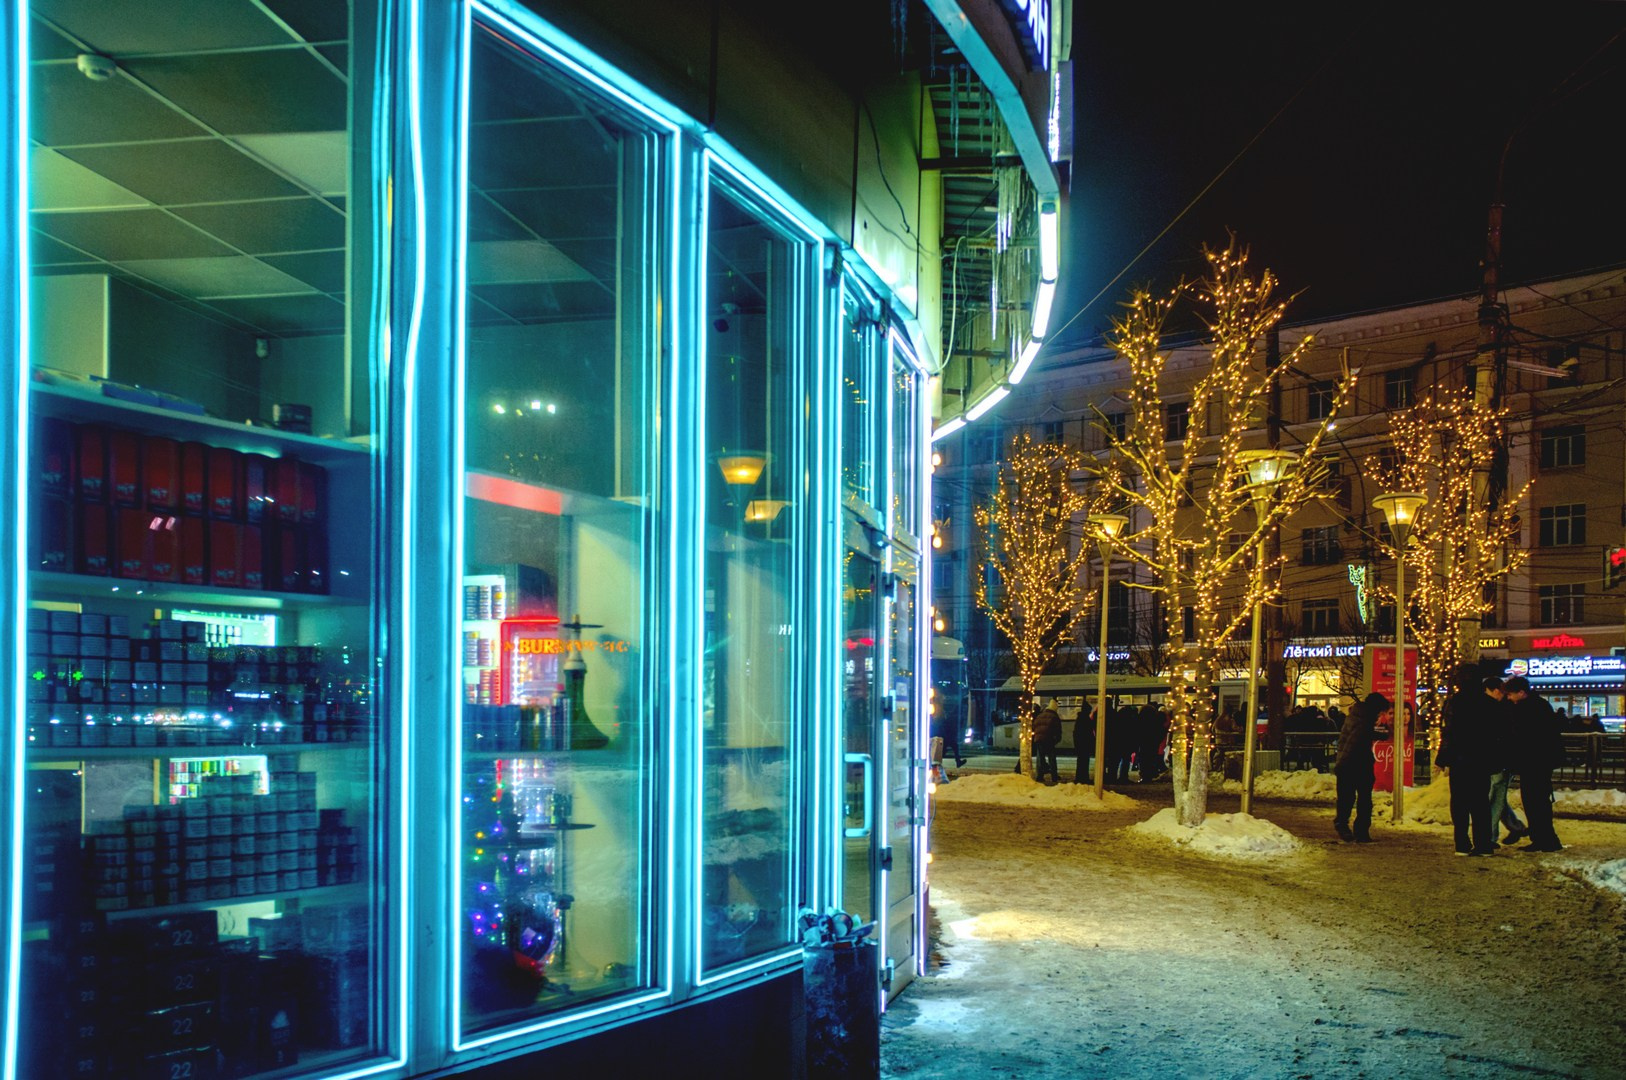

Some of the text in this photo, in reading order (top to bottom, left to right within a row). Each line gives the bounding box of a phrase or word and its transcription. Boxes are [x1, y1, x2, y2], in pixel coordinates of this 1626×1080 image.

[1283, 645, 1333, 658] Лёгкий
[173, 930, 193, 946] 22
[175, 974, 194, 991] 22
[173, 1018, 193, 1035] 22
[171, 1062, 192, 1080] 22
